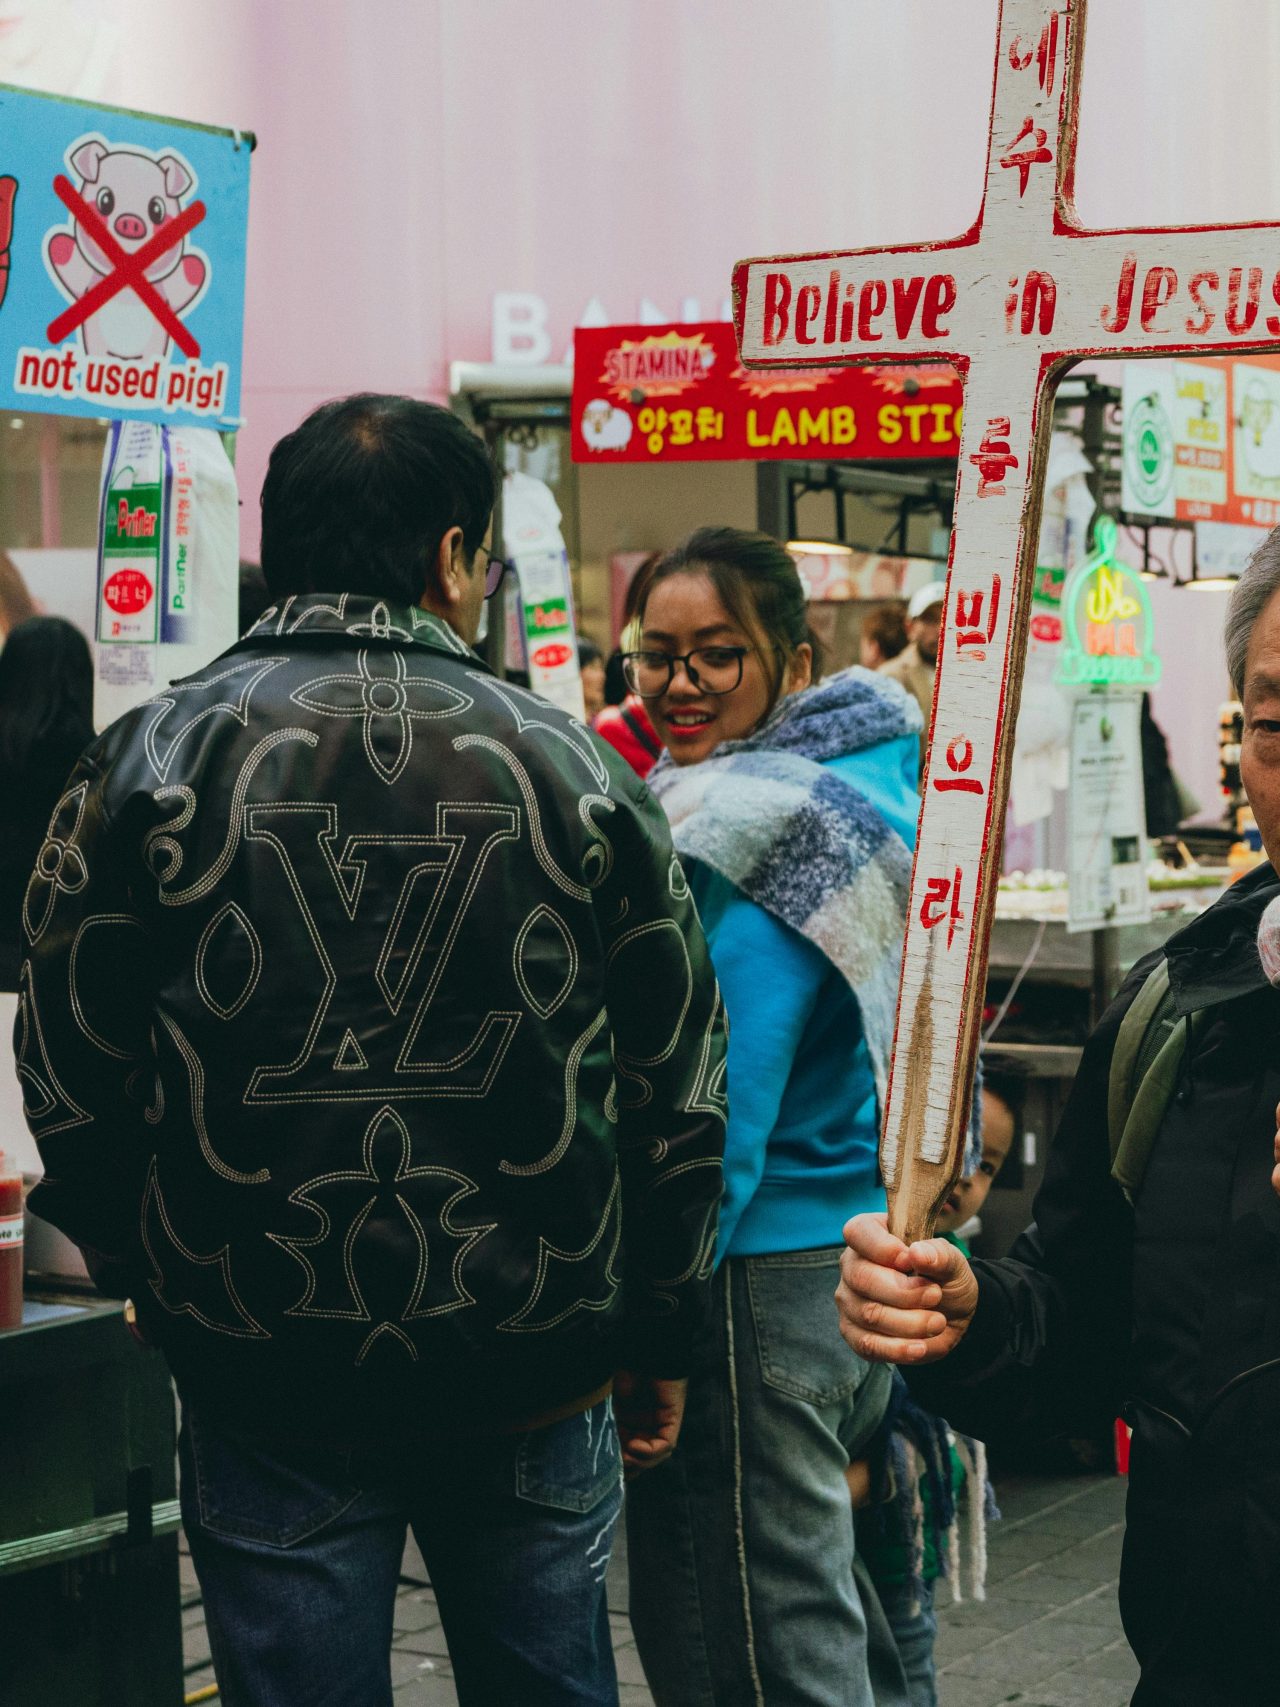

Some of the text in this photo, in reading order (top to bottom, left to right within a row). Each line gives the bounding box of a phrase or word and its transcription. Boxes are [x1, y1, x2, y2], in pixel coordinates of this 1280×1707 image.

[763, 269, 957, 346] Believe
[1005, 270, 1057, 336] in
[20, 351, 224, 409] not used pig!
[606, 346, 706, 381] STAMINA
[746, 403, 964, 448] LAMB STI
